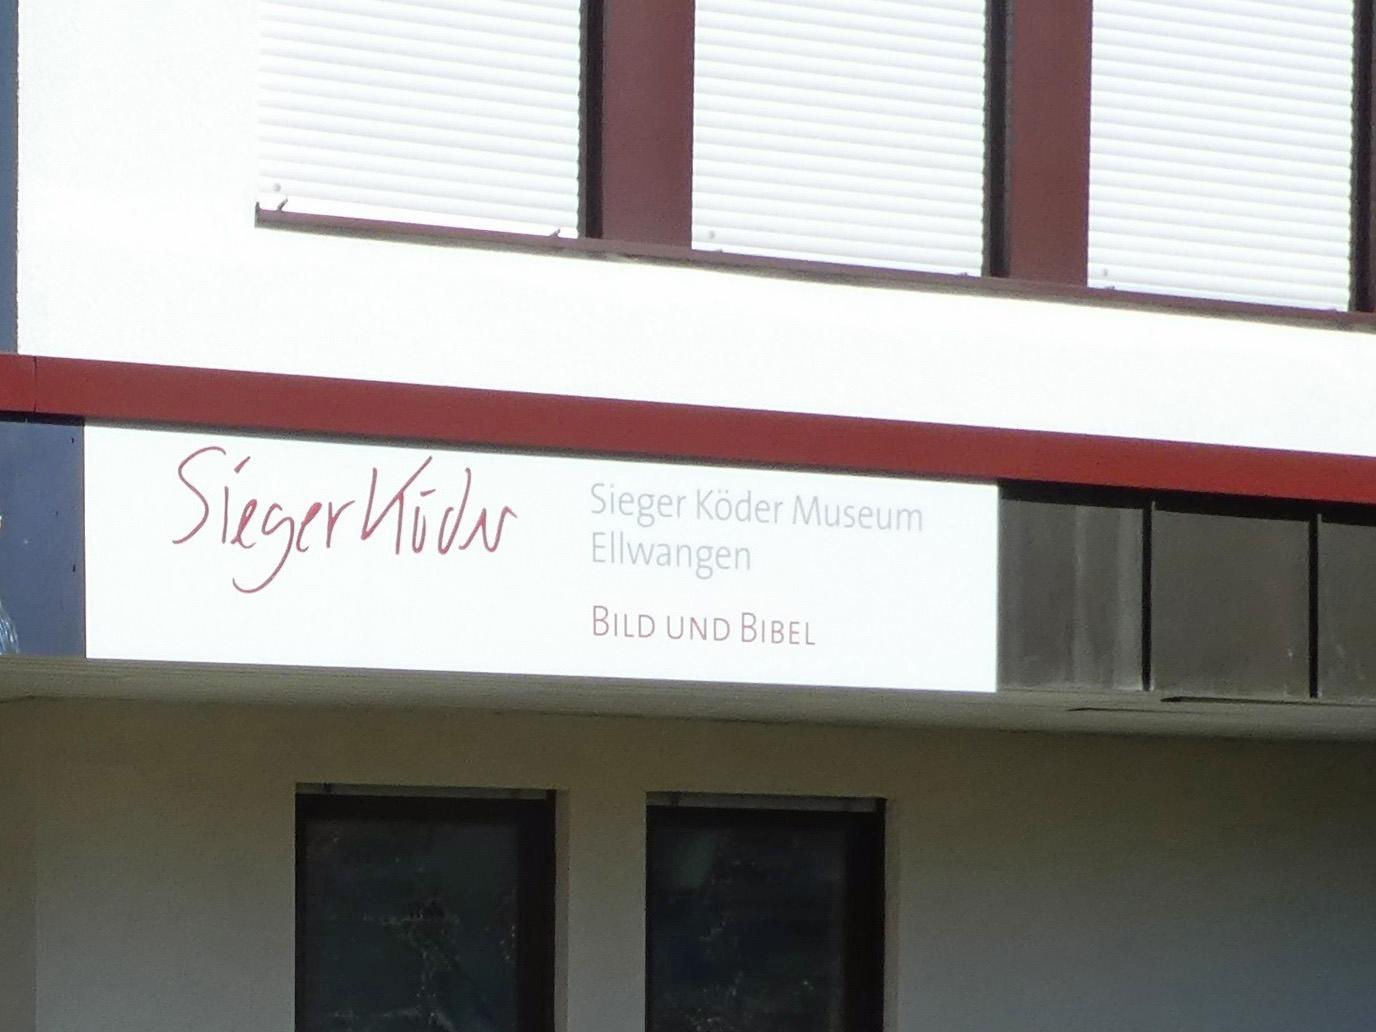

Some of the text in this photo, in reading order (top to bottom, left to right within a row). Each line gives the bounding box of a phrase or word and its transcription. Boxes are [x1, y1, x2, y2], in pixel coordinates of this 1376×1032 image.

[590, 482, 923, 532] Sieger Köder Museum
[591, 529, 751, 581] Ellwangen
[592, 604, 817, 646] BILD UND BIBEL
